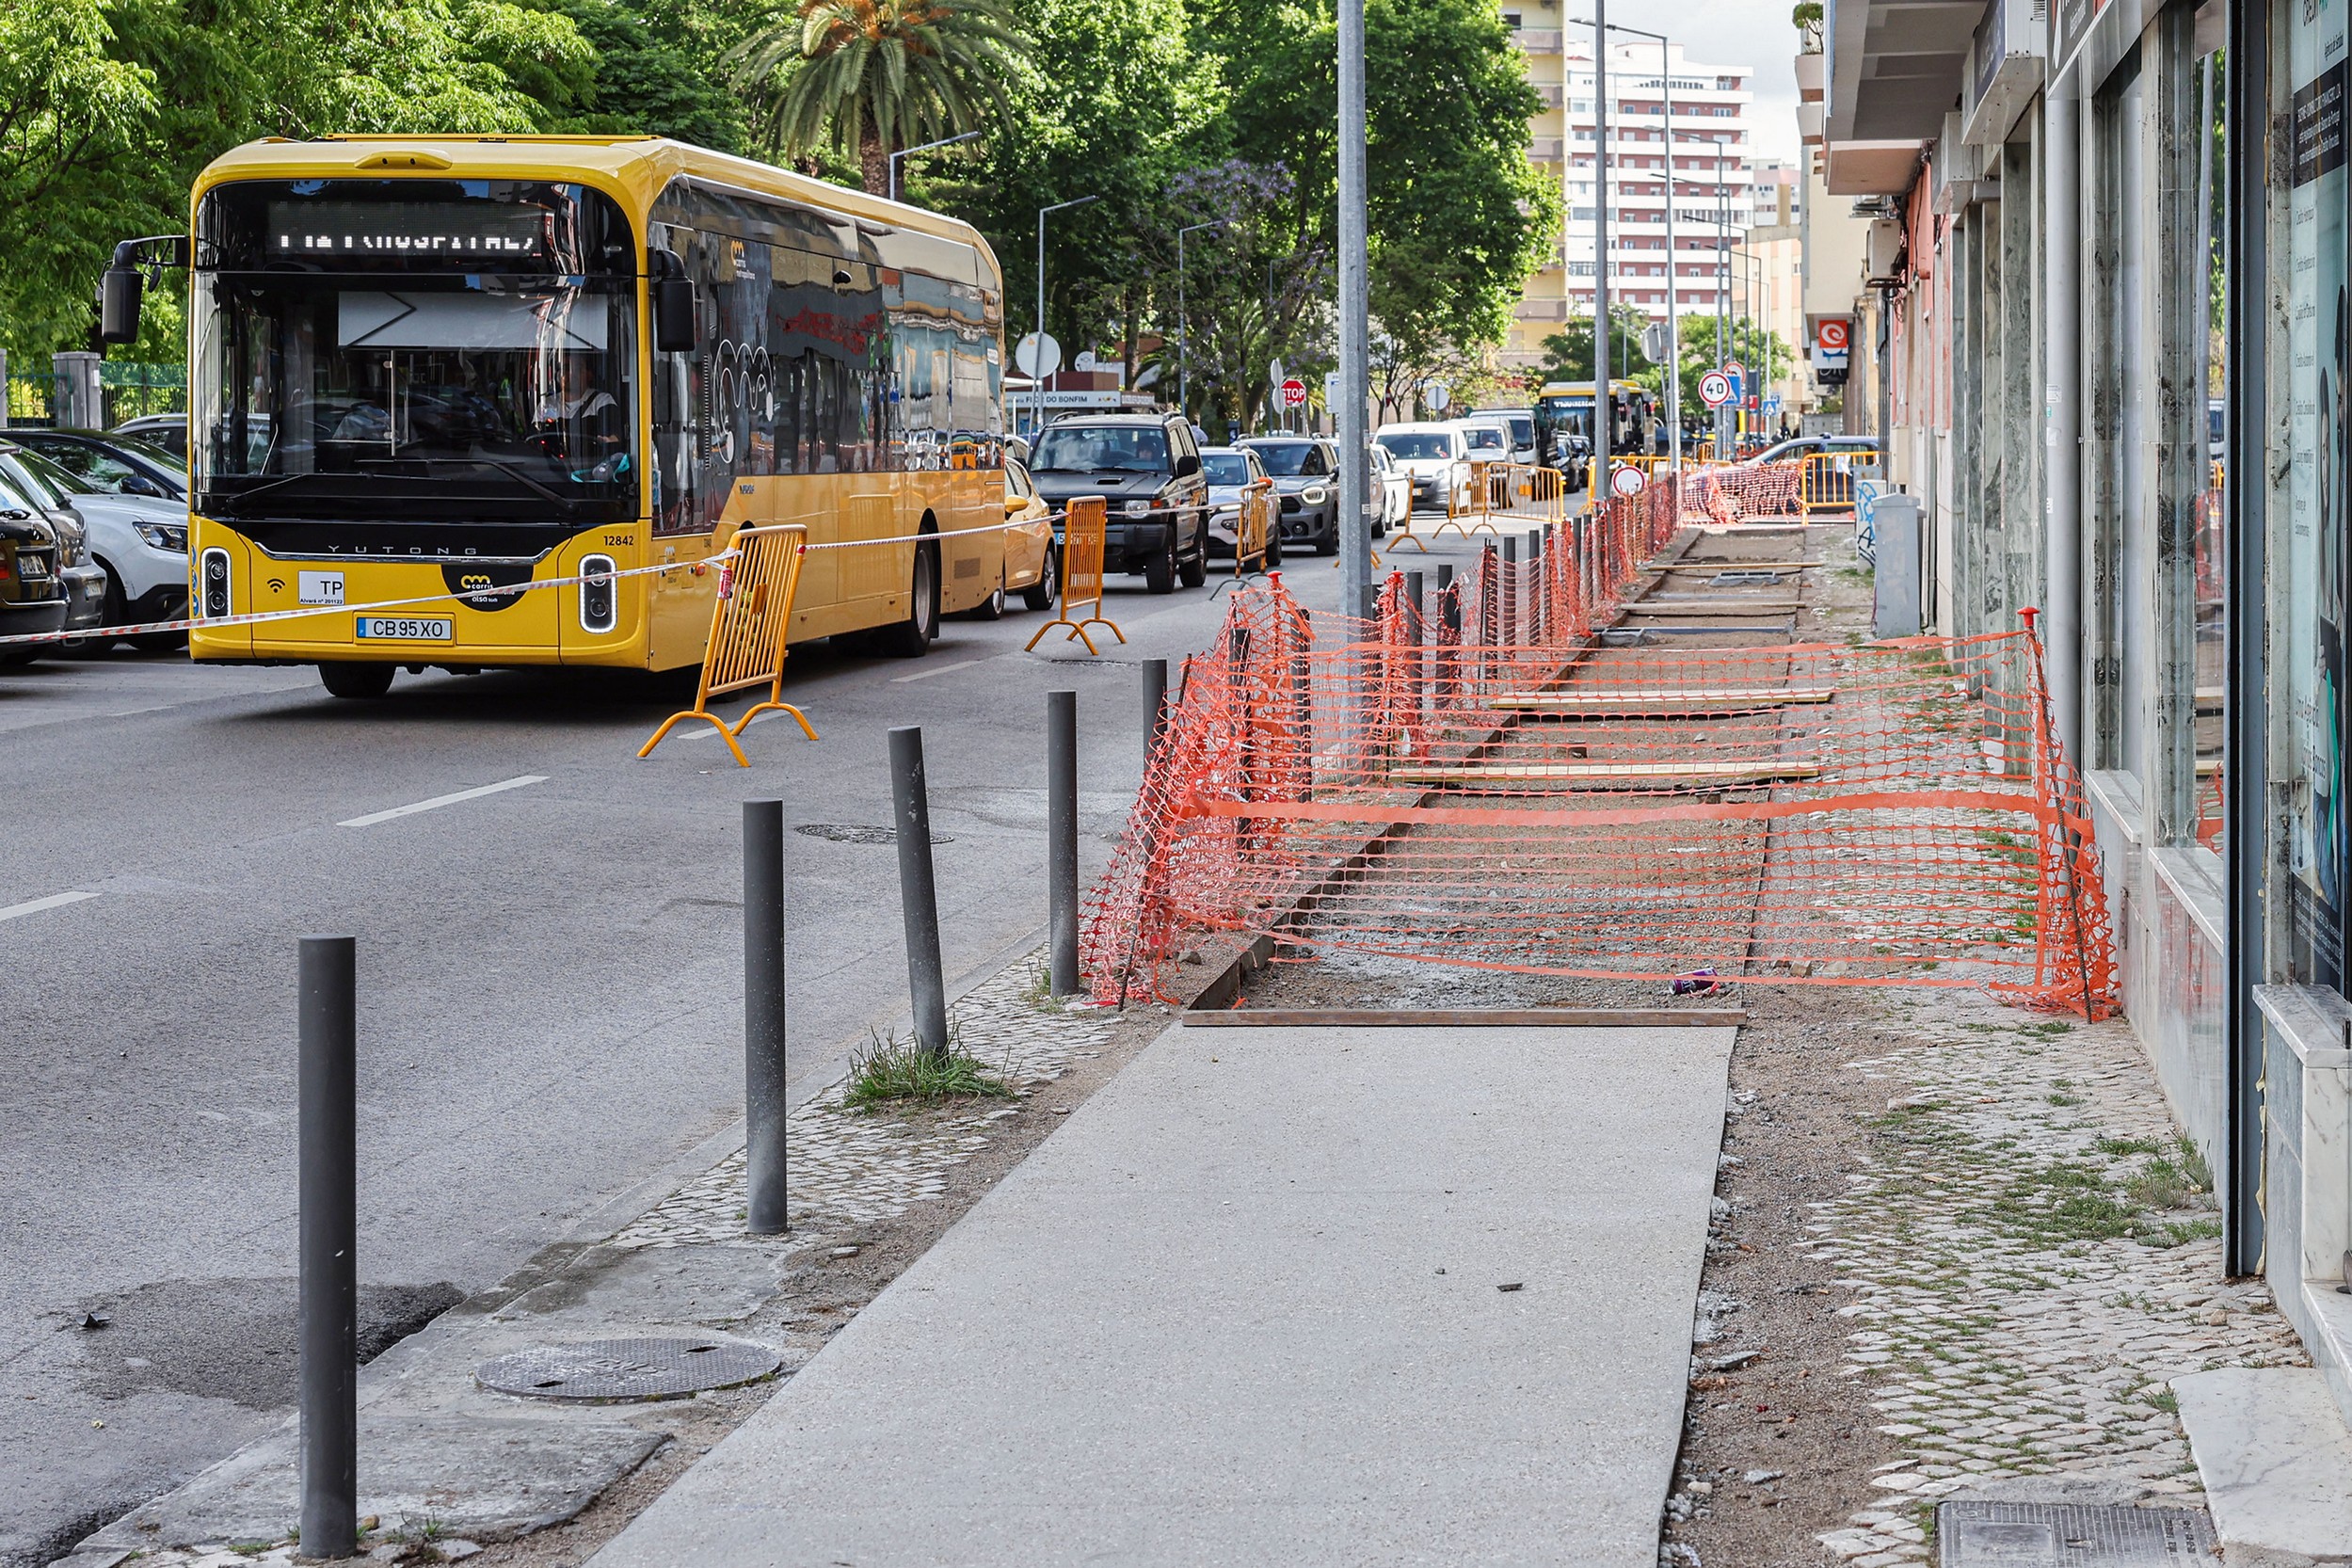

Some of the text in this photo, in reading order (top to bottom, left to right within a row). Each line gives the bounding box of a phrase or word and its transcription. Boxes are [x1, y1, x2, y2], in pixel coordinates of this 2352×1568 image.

[1282, 387, 1305, 399] STOP
[1705, 382, 1724, 395] 40
[603, 536, 634, 547] 12842
[328, 545, 477, 556] YUTONG
[320, 580, 344, 596] TP
[373, 620, 396, 636] CB
[398, 621, 417, 637] 95
